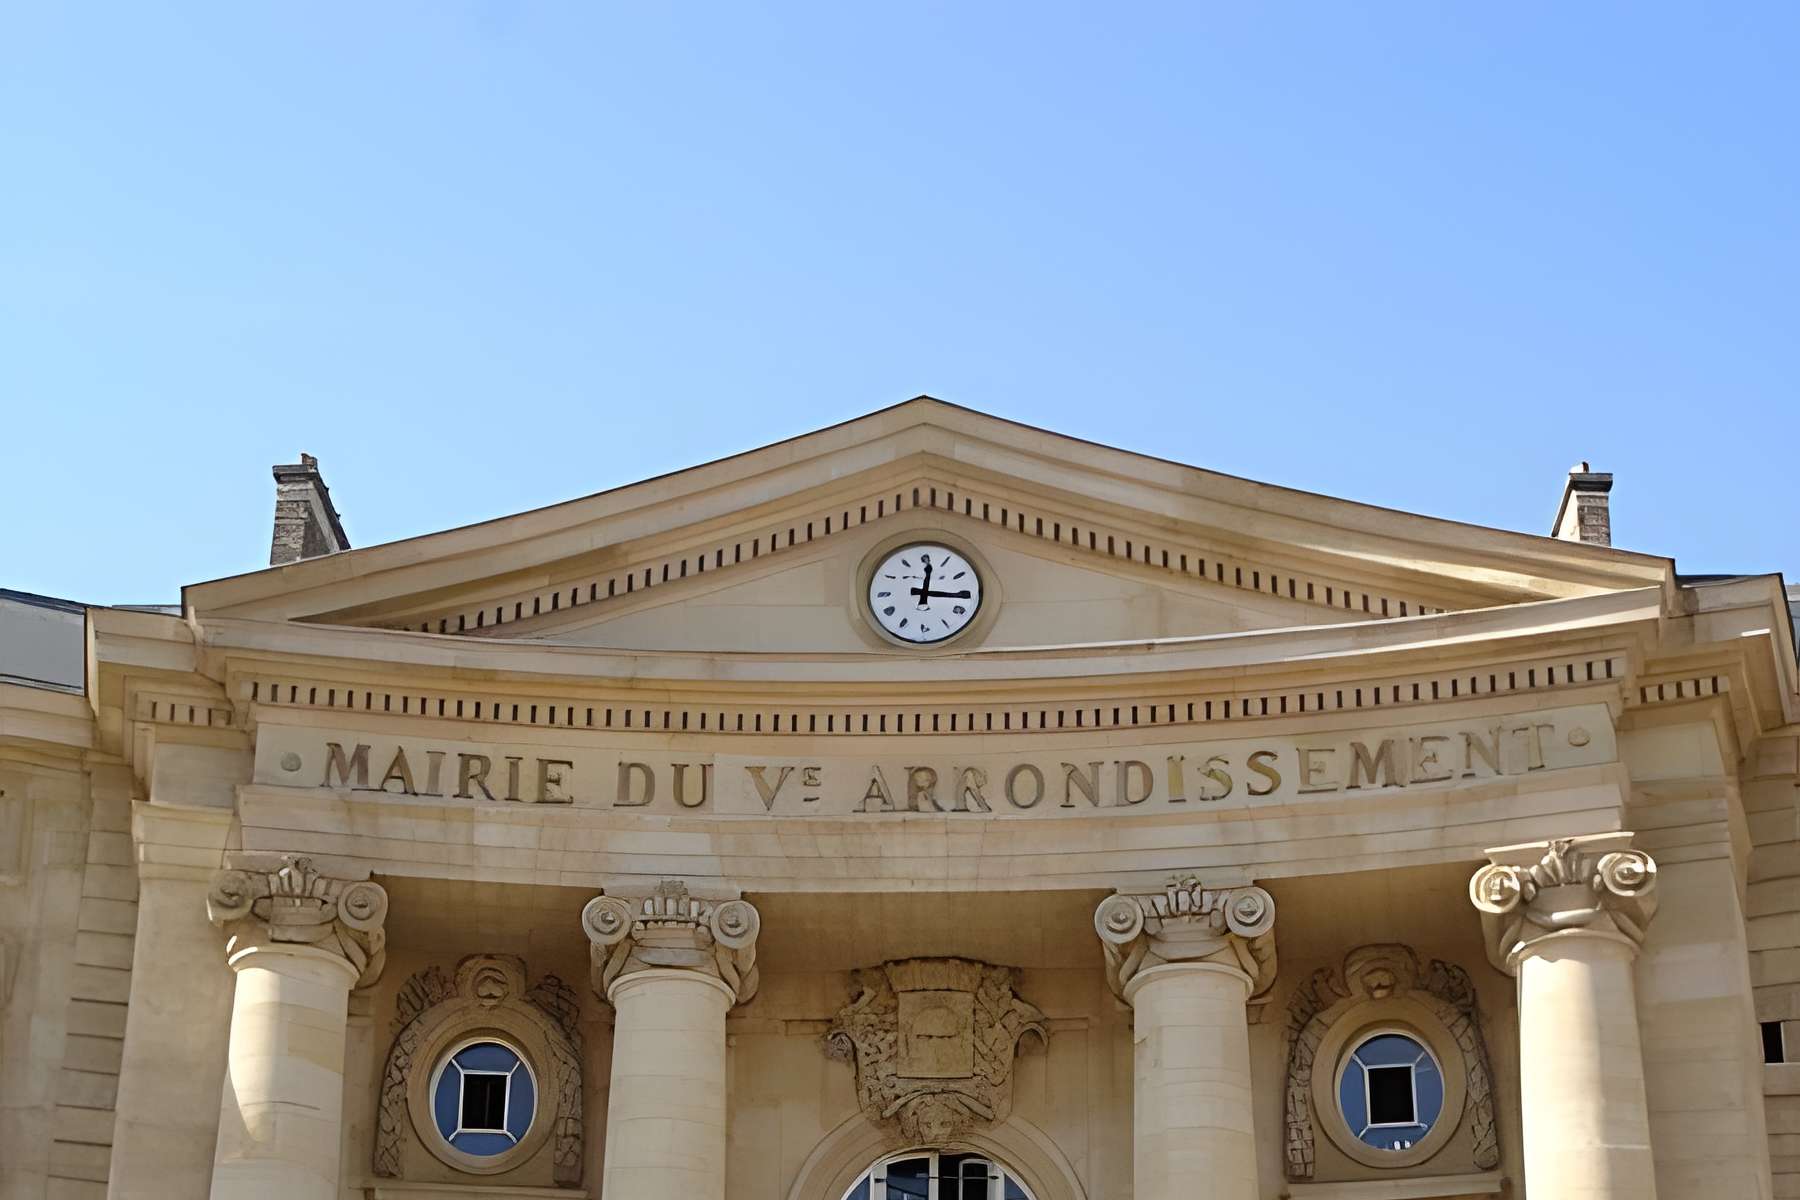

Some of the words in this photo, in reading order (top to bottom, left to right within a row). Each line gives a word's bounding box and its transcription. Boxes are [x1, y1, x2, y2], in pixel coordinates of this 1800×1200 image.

[319, 741, 575, 805] MAIRIE
[612, 760, 715, 809] DU
[852, 723, 1556, 813] ARRONDISSEMENT
